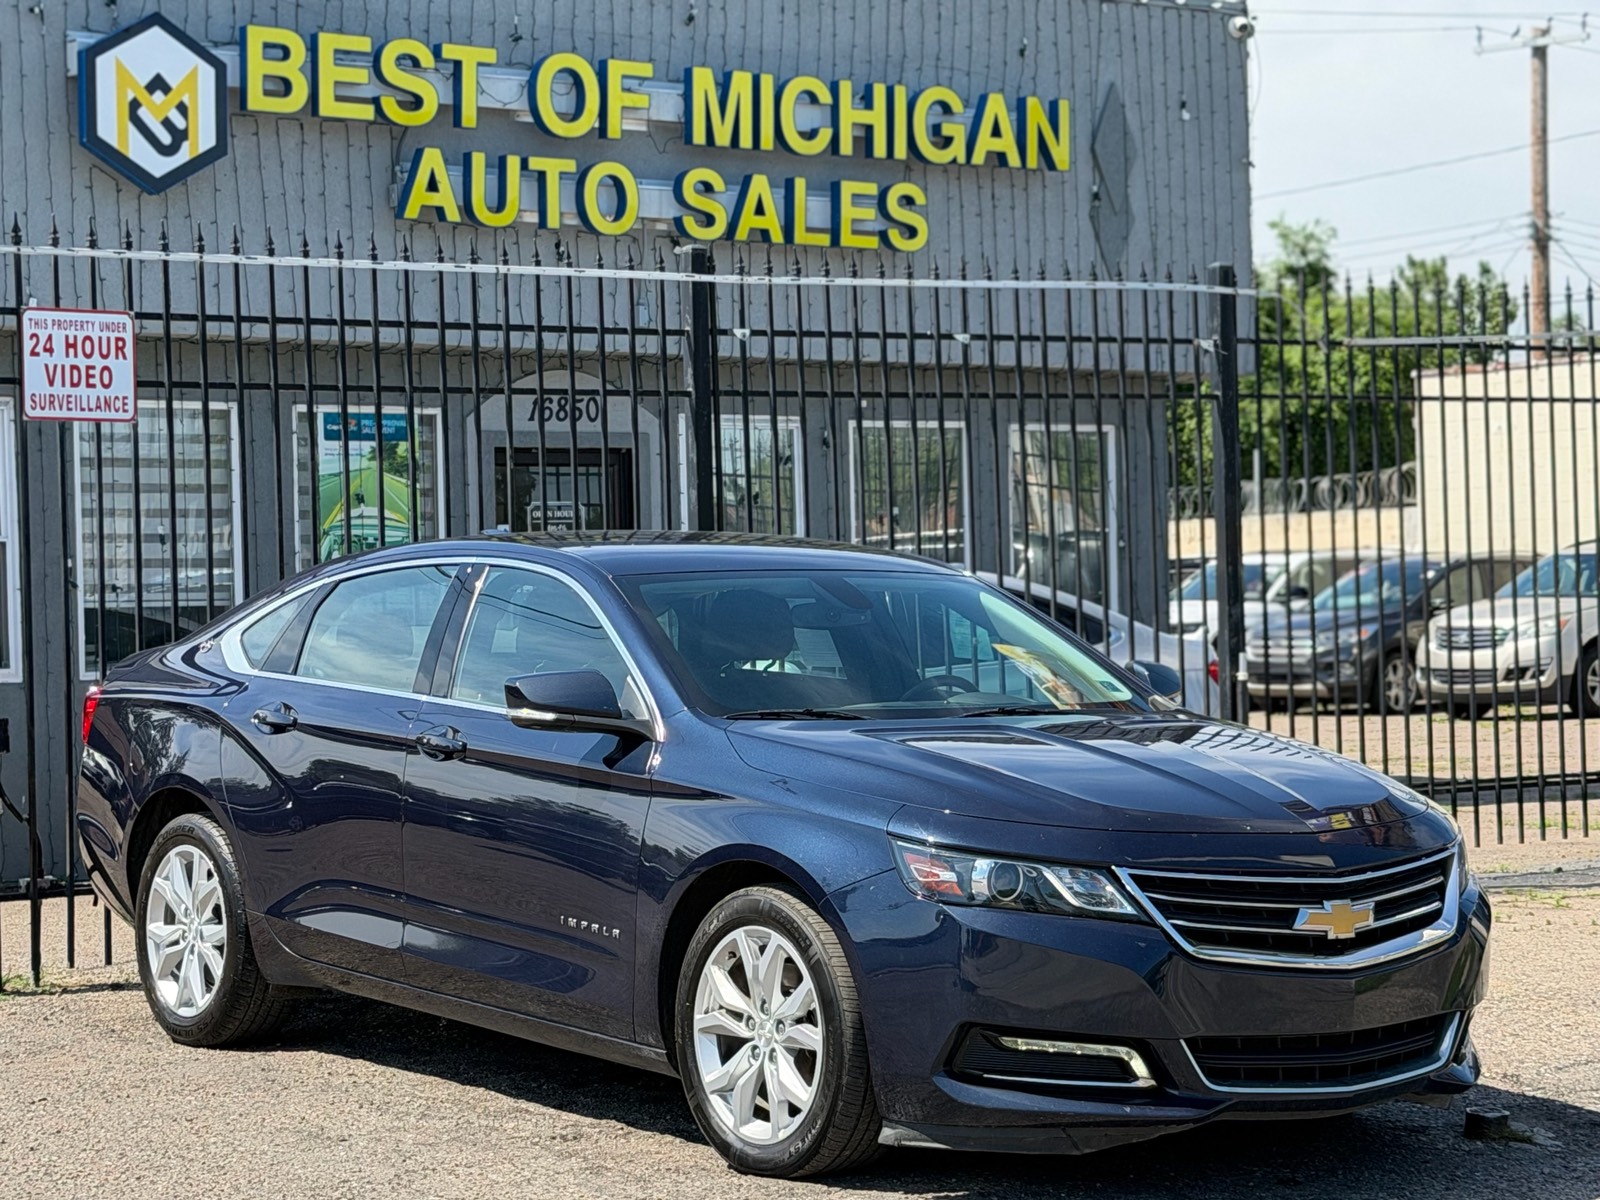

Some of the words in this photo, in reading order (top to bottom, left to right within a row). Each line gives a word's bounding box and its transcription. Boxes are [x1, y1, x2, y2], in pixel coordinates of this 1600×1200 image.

[243, 25, 497, 129] BEST
[532, 53, 654, 139] OF
[687, 67, 1071, 171] MICHIGAN
[400, 147, 638, 235] AUTO
[676, 168, 928, 251] SALES
[28, 318, 48, 330] THIS
[51, 319, 96, 332] PROPERTY
[98, 321, 127, 333] UNDER
[29, 333, 55, 357] 24
[64, 334, 128, 360] HOUR
[44, 363, 114, 389] VIDEO
[29, 393, 129, 413] SURVEILLANCE
[527, 396, 600, 423] 16850
[560, 915, 620, 939] IMPALA
